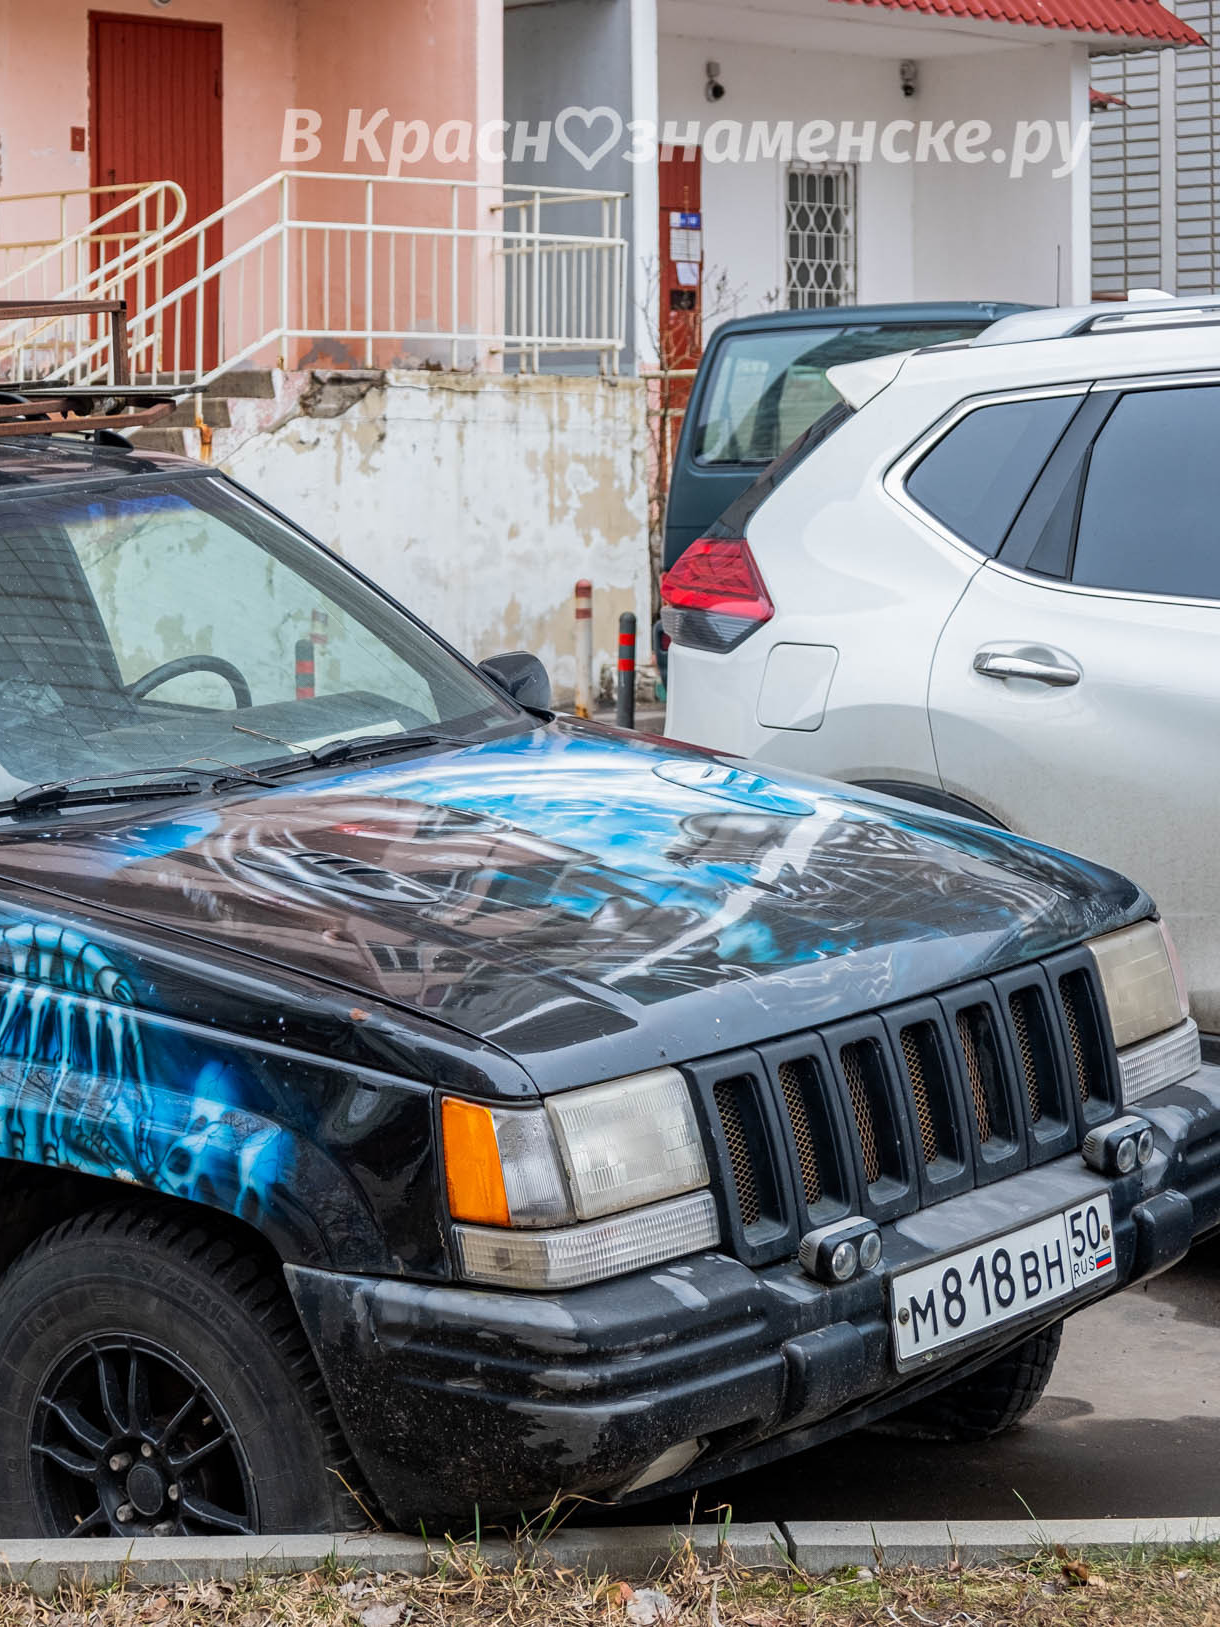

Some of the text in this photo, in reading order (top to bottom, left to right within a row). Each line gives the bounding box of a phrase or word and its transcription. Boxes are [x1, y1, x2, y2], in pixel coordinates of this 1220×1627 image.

[909, 1205, 1101, 1344] М818ВН 50
[1073, 1255, 1096, 1280] RUS
